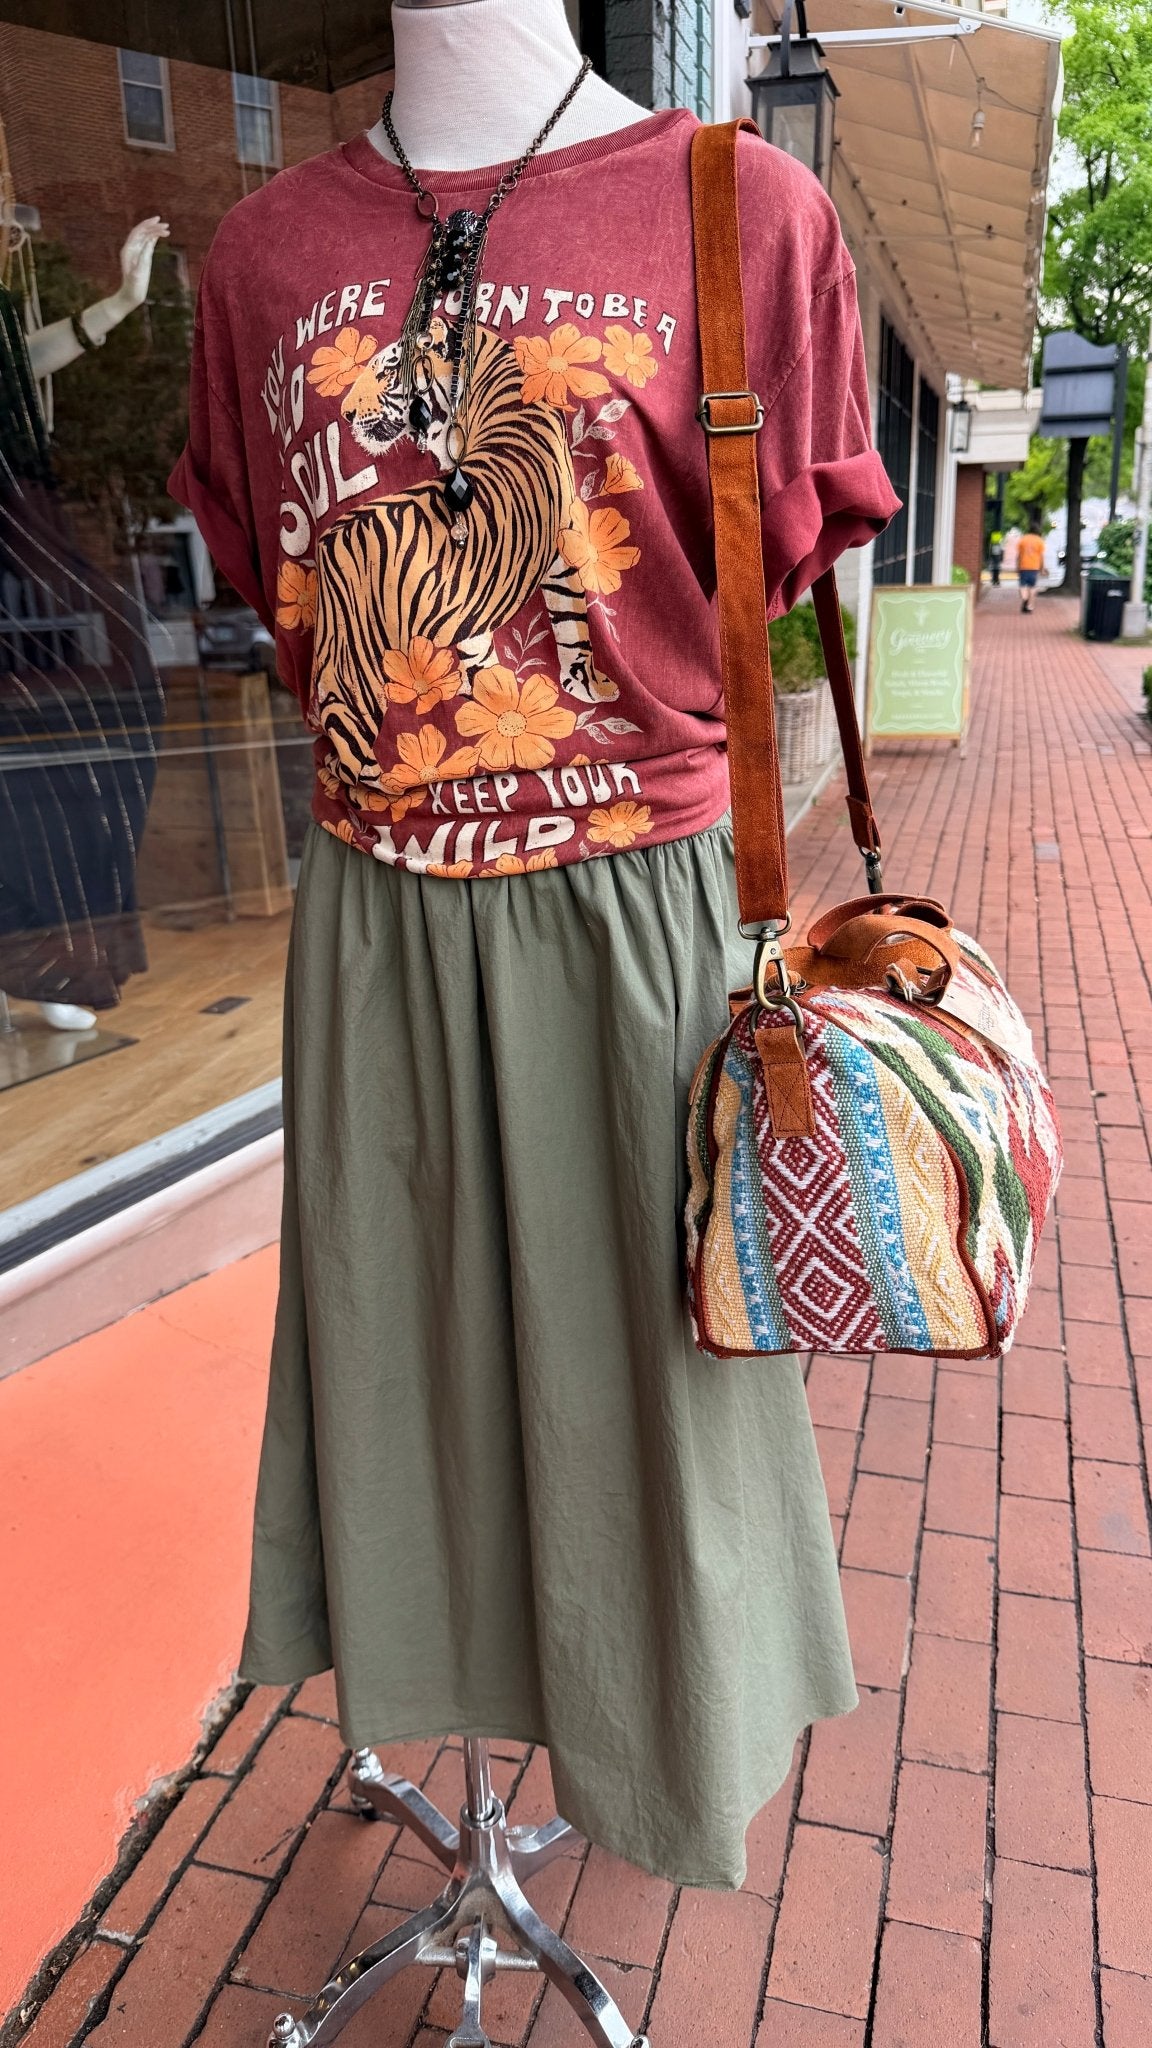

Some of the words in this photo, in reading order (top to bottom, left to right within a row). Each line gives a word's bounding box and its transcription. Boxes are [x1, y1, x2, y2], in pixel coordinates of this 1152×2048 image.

[260, 333, 285, 436] YOU
[295, 278, 391, 351] WERE
[432, 281, 530, 328] ORN
[541, 287, 596, 326] TO
[601, 292, 648, 329] BE
[653, 312, 677, 356] A
[428, 772, 519, 815] KEEP
[534, 762, 643, 809] YOUR
[371, 814, 576, 876] WILD
